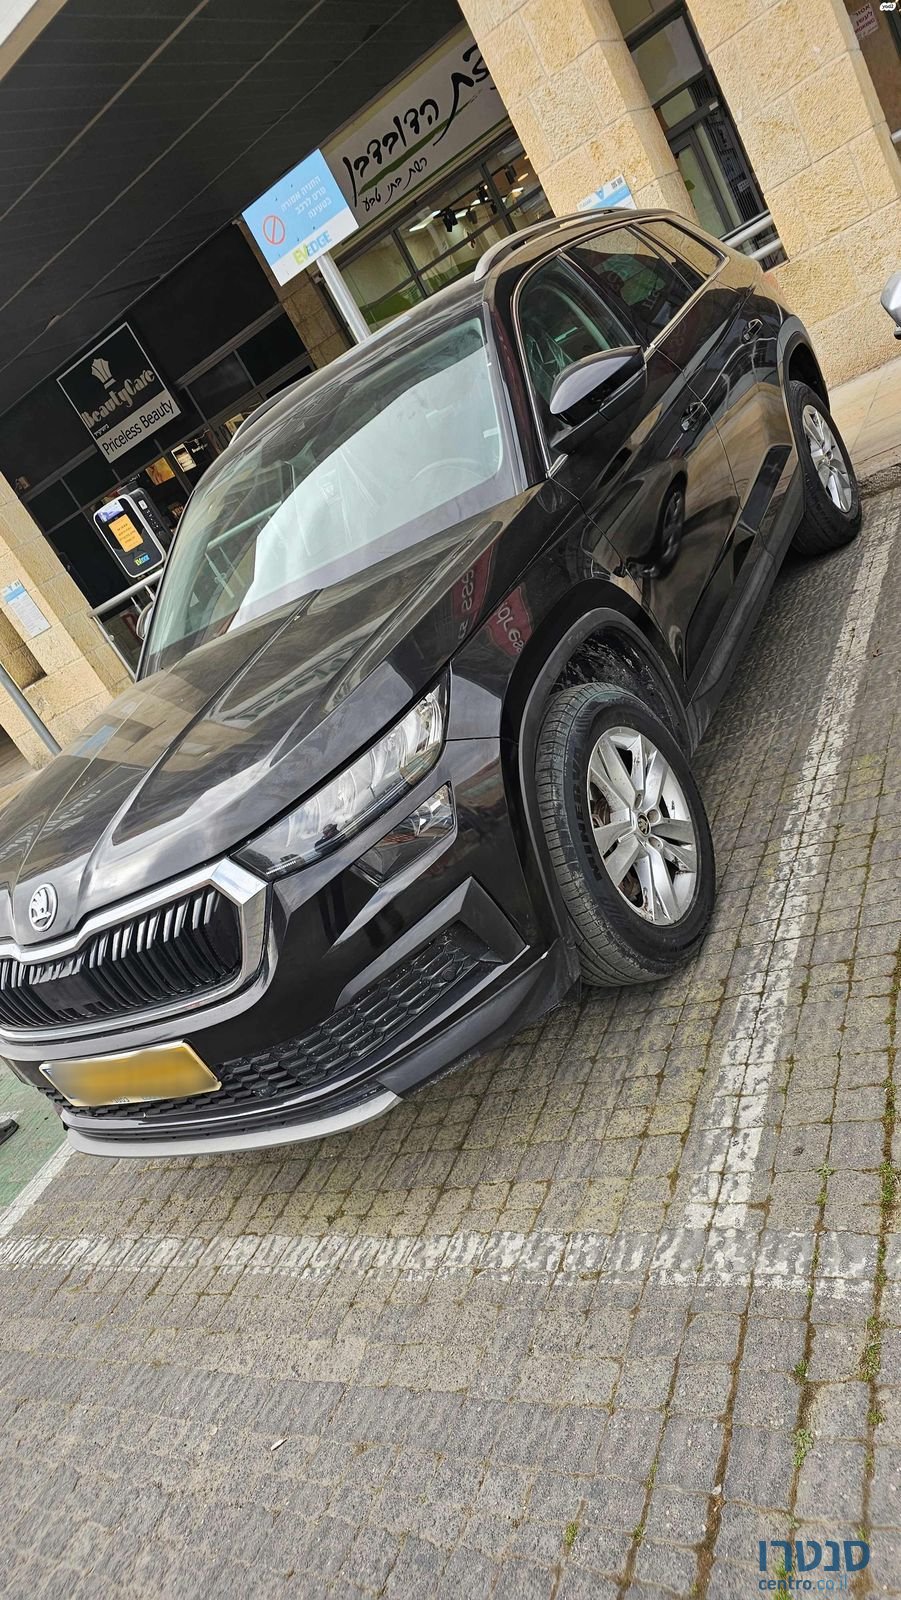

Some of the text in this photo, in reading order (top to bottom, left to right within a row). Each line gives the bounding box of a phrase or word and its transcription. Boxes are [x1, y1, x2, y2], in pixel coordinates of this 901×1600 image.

[343, 98, 440, 207] הדובדבן
[314, 186, 327, 200] פרט
[362, 157, 428, 212] רשת בתי טבע
[102, 423, 143, 456] Priceless
[139, 399, 175, 429] Beauty
